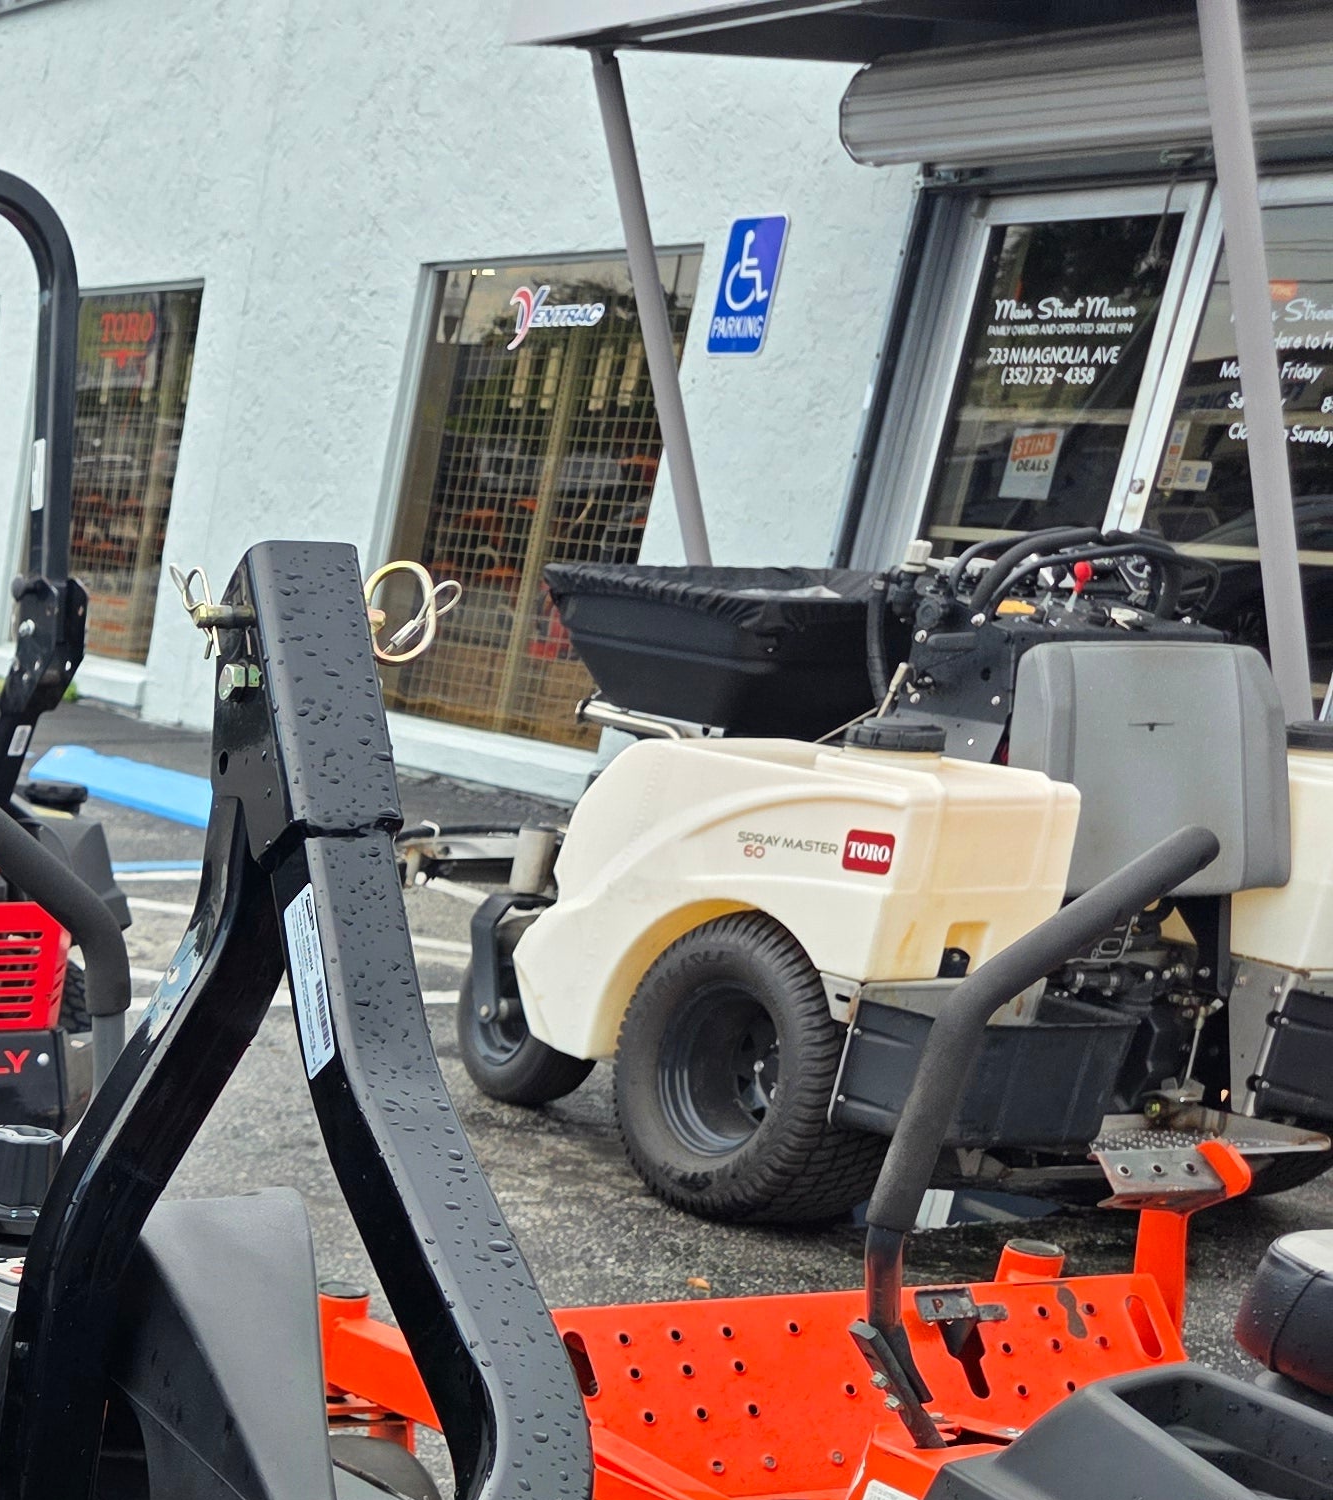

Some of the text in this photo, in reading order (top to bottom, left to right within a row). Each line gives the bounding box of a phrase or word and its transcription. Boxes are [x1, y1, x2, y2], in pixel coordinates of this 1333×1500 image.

[507, 285, 605, 350] VENTRAC
[994, 296, 1137, 320] Main Street Mower
[1284, 297, 1333, 323] Stree
[100, 311, 155, 344] TORO
[710, 315, 764, 339] PARKING
[986, 324, 1012, 337] FAMILY
[1011, 323, 1040, 336] OWNED
[1039, 323, 1056, 336] AND
[1056, 322, 1095, 335] OPERATED
[1095, 322, 1117, 335] SINCE
[1304, 332, 1320, 350] to
[986, 345, 1121, 365] 733 N MAGNOLIA AVE
[1001, 366, 1033, 386] (352)
[1280, 361, 1324, 384] Friday
[1015, 435, 1052, 457] STIHL
[1016, 458, 1050, 474] DEALS
[737, 830, 838, 856] SPRAY MASTER
[743, 843, 766, 859] 60
[847, 840, 890, 863] TORO
